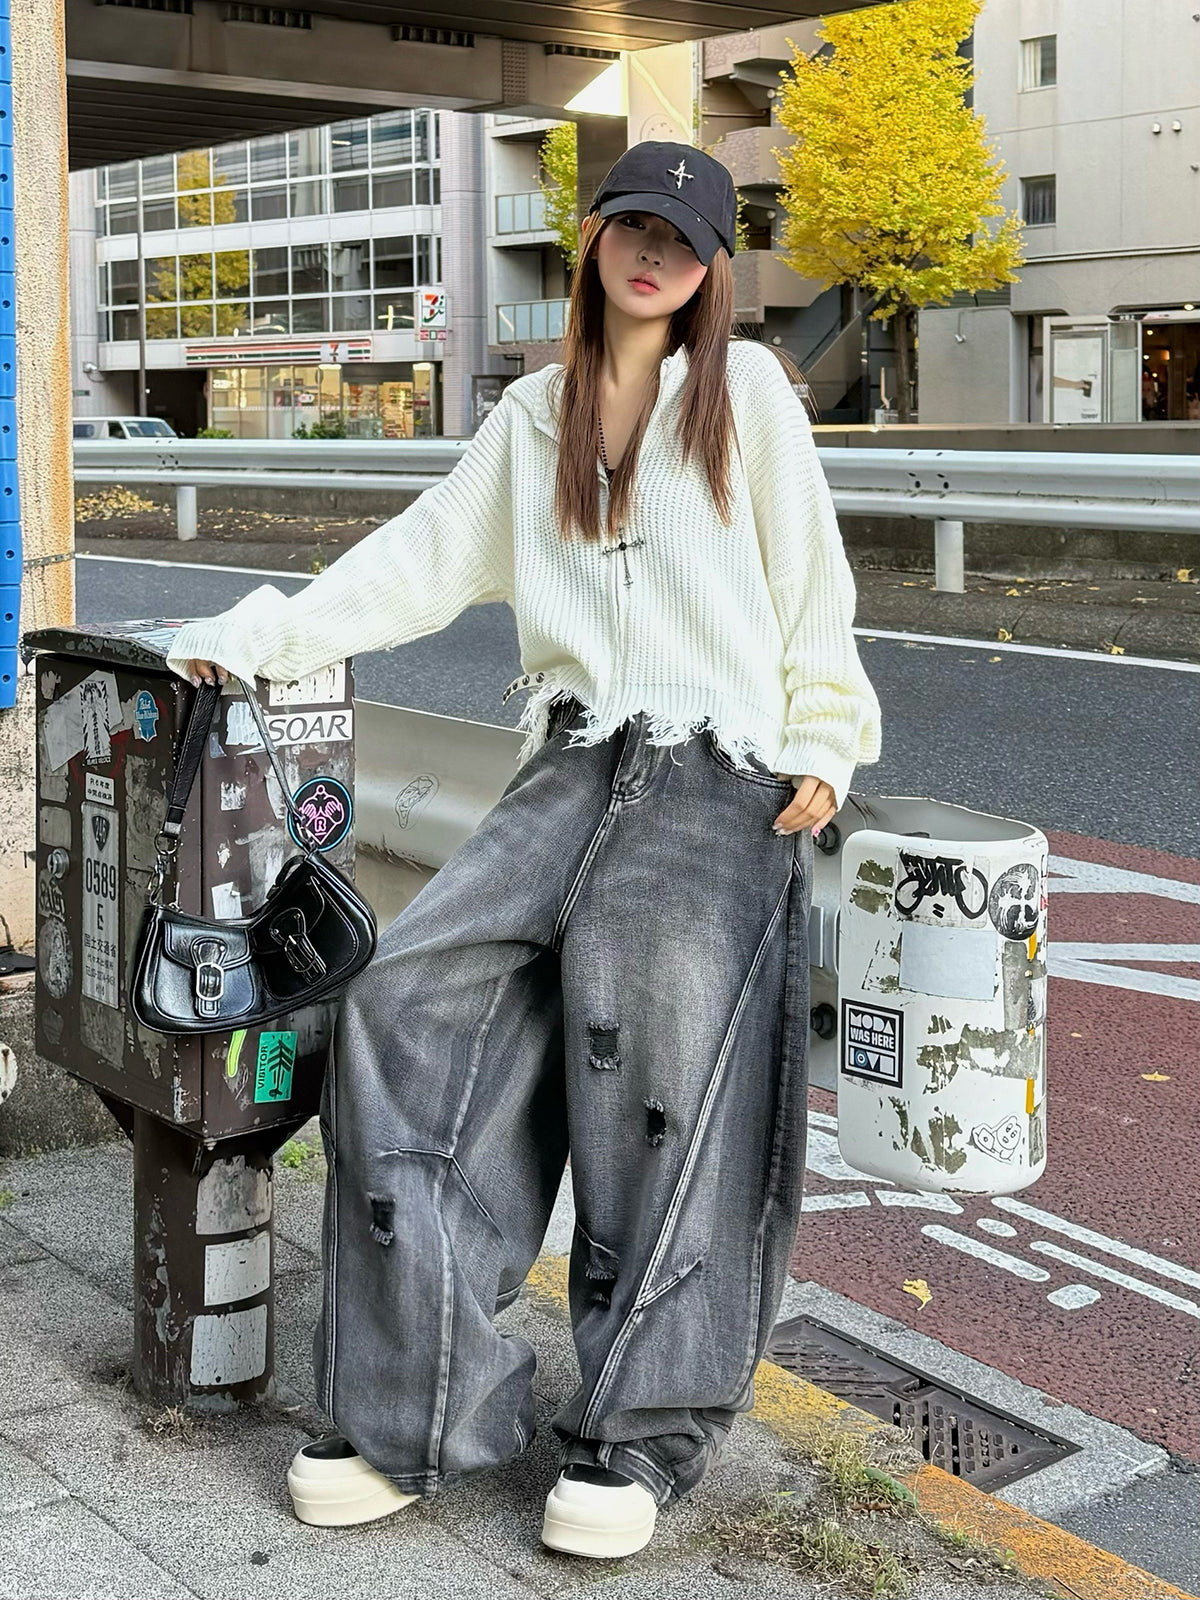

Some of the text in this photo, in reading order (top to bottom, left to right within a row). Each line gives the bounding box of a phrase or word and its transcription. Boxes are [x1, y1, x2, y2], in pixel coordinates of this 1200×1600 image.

[269, 715, 349, 742] SOAR
[86, 857, 116, 901] 0589
[97, 903, 104, 931] E
[84, 933, 116, 958] 国土交通省
[850, 1011, 894, 1035] MODA
[850, 1026, 894, 1049] WAS HERE
